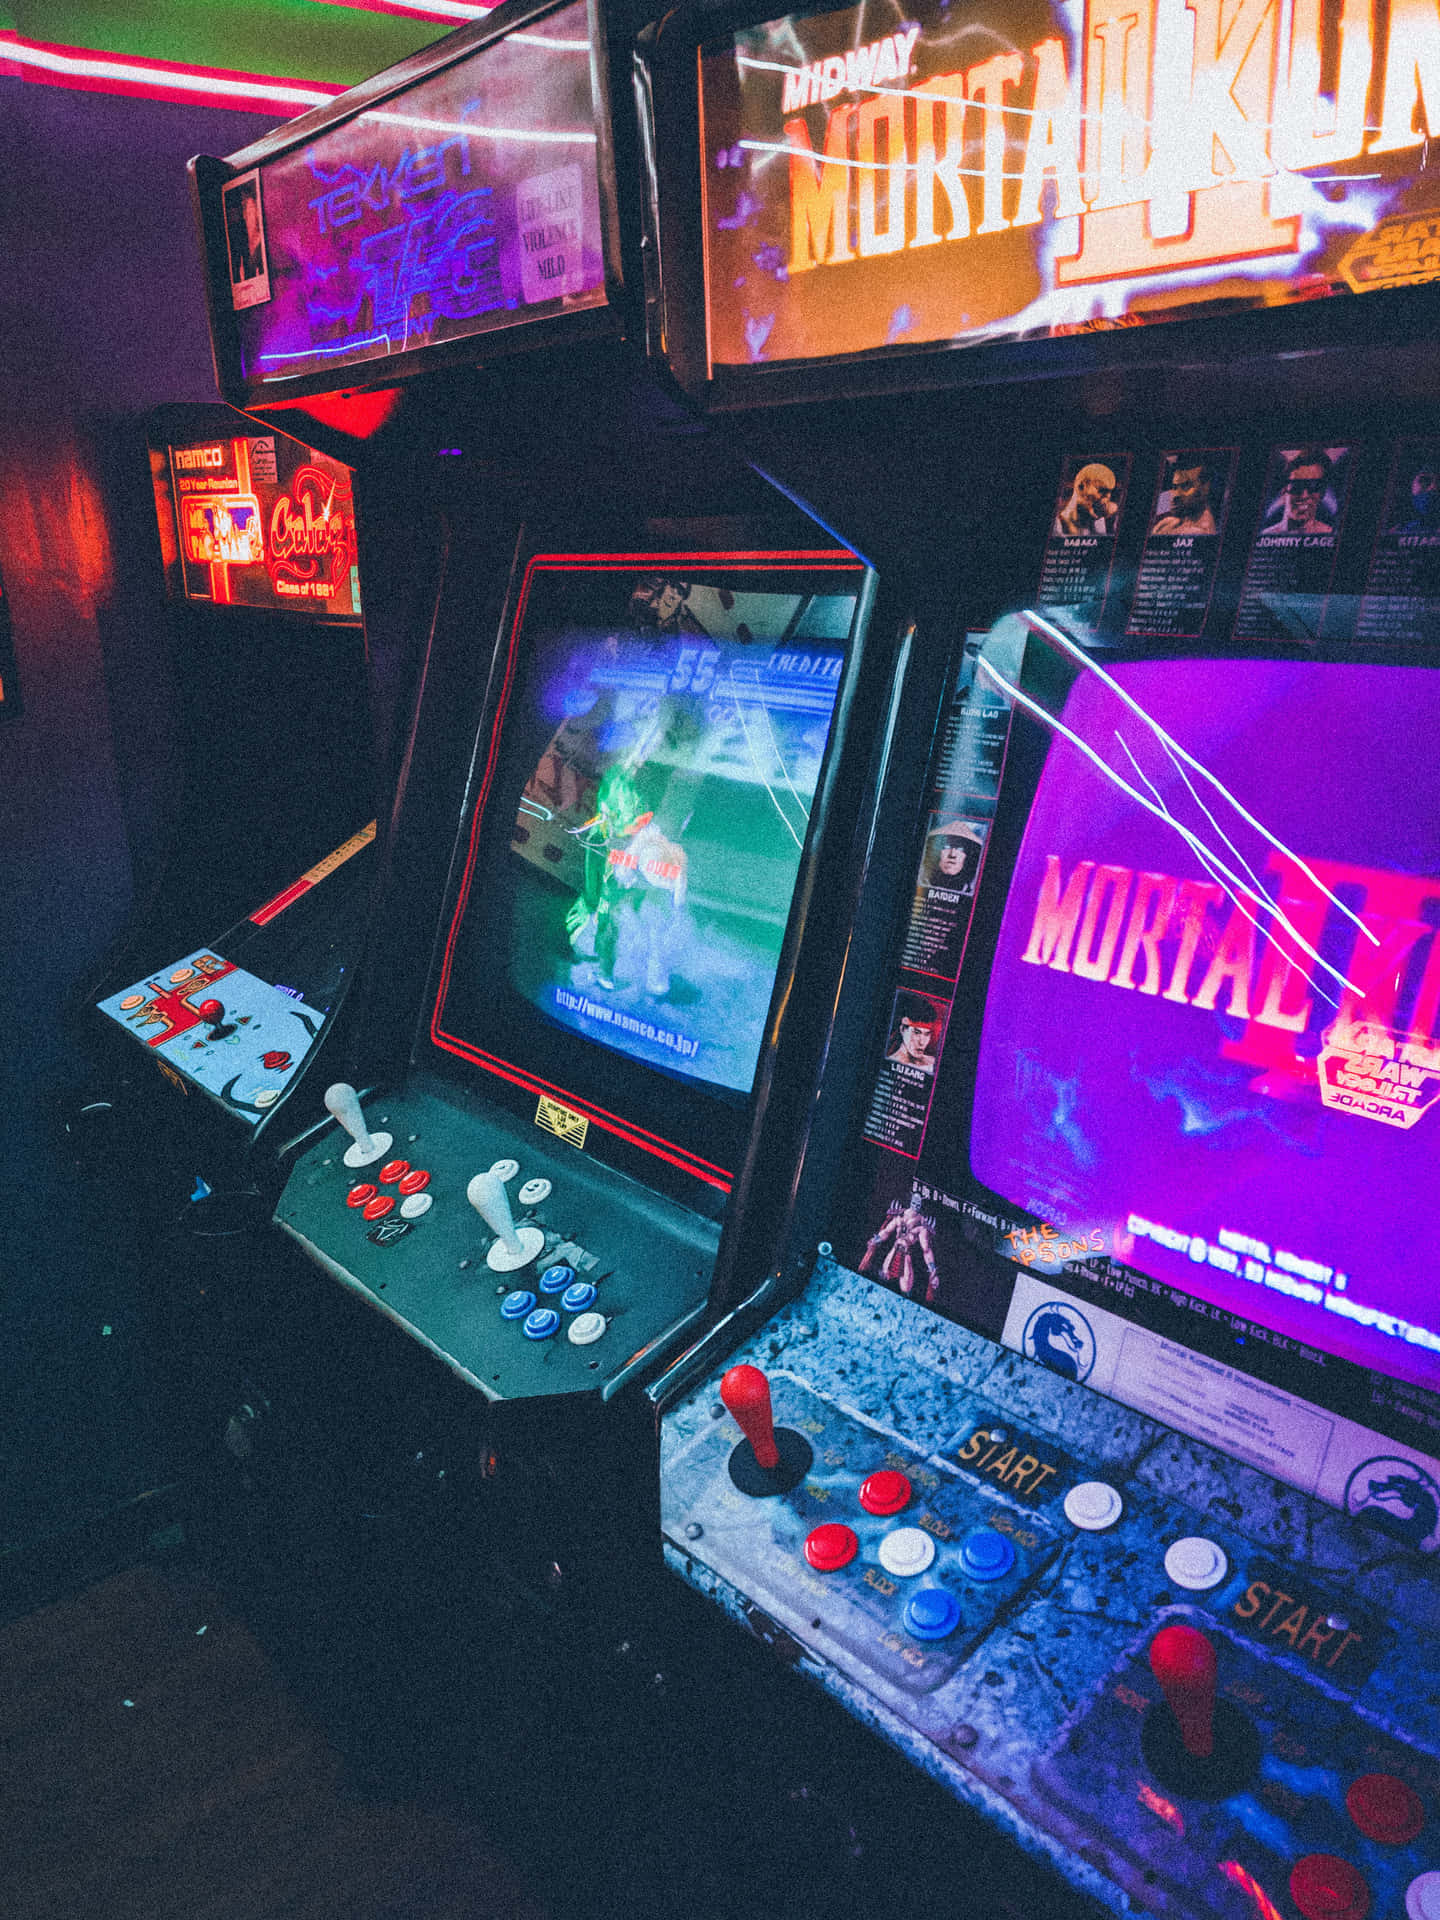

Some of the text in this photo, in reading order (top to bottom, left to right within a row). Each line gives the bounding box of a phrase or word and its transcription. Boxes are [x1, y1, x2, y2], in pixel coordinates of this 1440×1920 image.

[783, 13, 1153, 273] MORTAL
[308, 132, 473, 234] TEKKEN
[537, 254, 566, 281] MILD
[175, 446, 223, 470] namco
[179, 477, 238, 491] 20 Year Reunion
[1172, 538, 1195, 548] JAX
[1256, 536, 1335, 548] JOHNNY CAGE
[276, 580, 336, 598] Class of 1981
[928, 889, 960, 904] RAIDEN
[1022, 854, 1313, 1033] MORTAL
[555, 987, 699, 1058] http://www.namco.co.jp/
[1002, 1222, 1060, 1250] THE
[957, 1429, 1057, 1495] START
[917, 1513, 952, 1538] BLOCK
[863, 1569, 898, 1596] BLOCK
[1233, 1581, 1363, 1668] START
